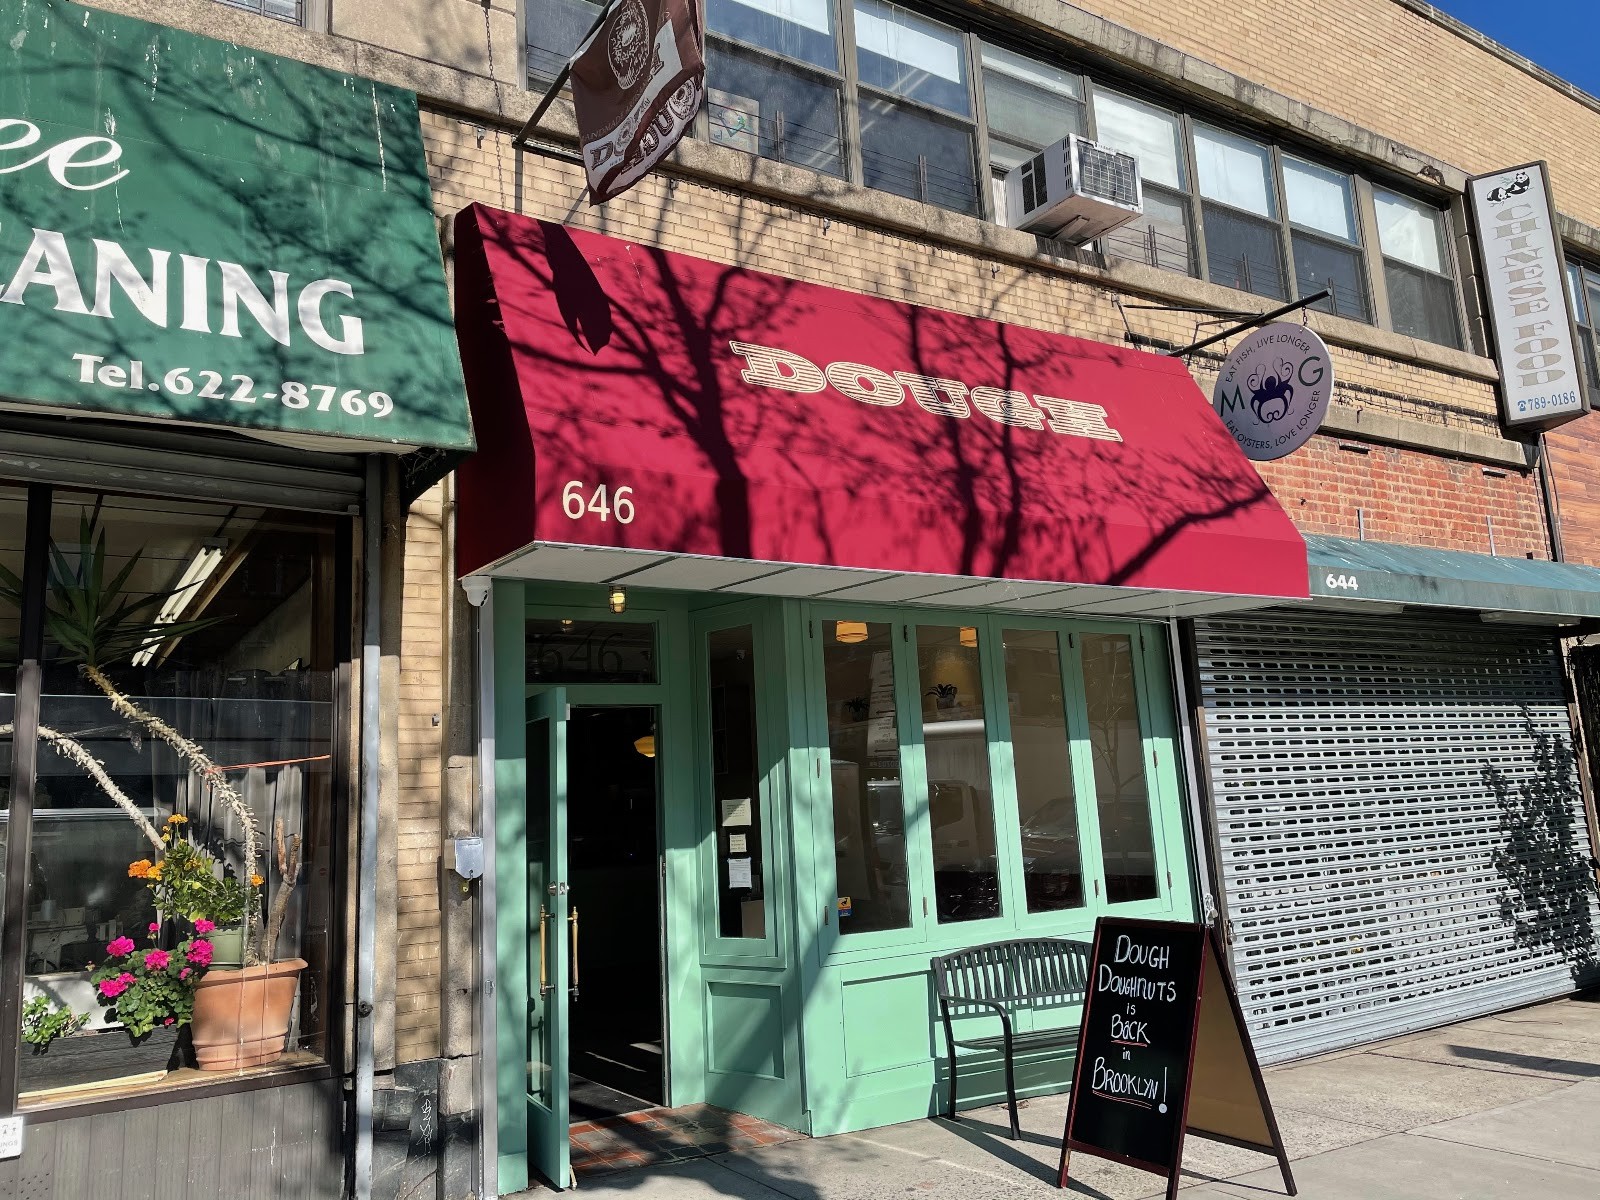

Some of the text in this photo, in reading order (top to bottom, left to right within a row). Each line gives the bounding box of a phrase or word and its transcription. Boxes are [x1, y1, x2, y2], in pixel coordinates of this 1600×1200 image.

[0, 225, 365, 355] ANING
[1493, 202, 1566, 389] CHINESE FOOD
[1225, 334, 1311, 383] EAT FISH, LIVE LONGER
[729, 340, 1123, 442] DOUGH
[1527, 391, 1577, 411] 789-0186
[1225, 390, 1321, 449] EAT OYSTERS, LOVE LONGER
[562, 481, 635, 525] 646
[1325, 573, 1359, 591] 644
[1114, 934, 1170, 970] DOUGH
[1126, 1002, 1136, 1015] is
[1122, 1046, 1131, 1061] in
